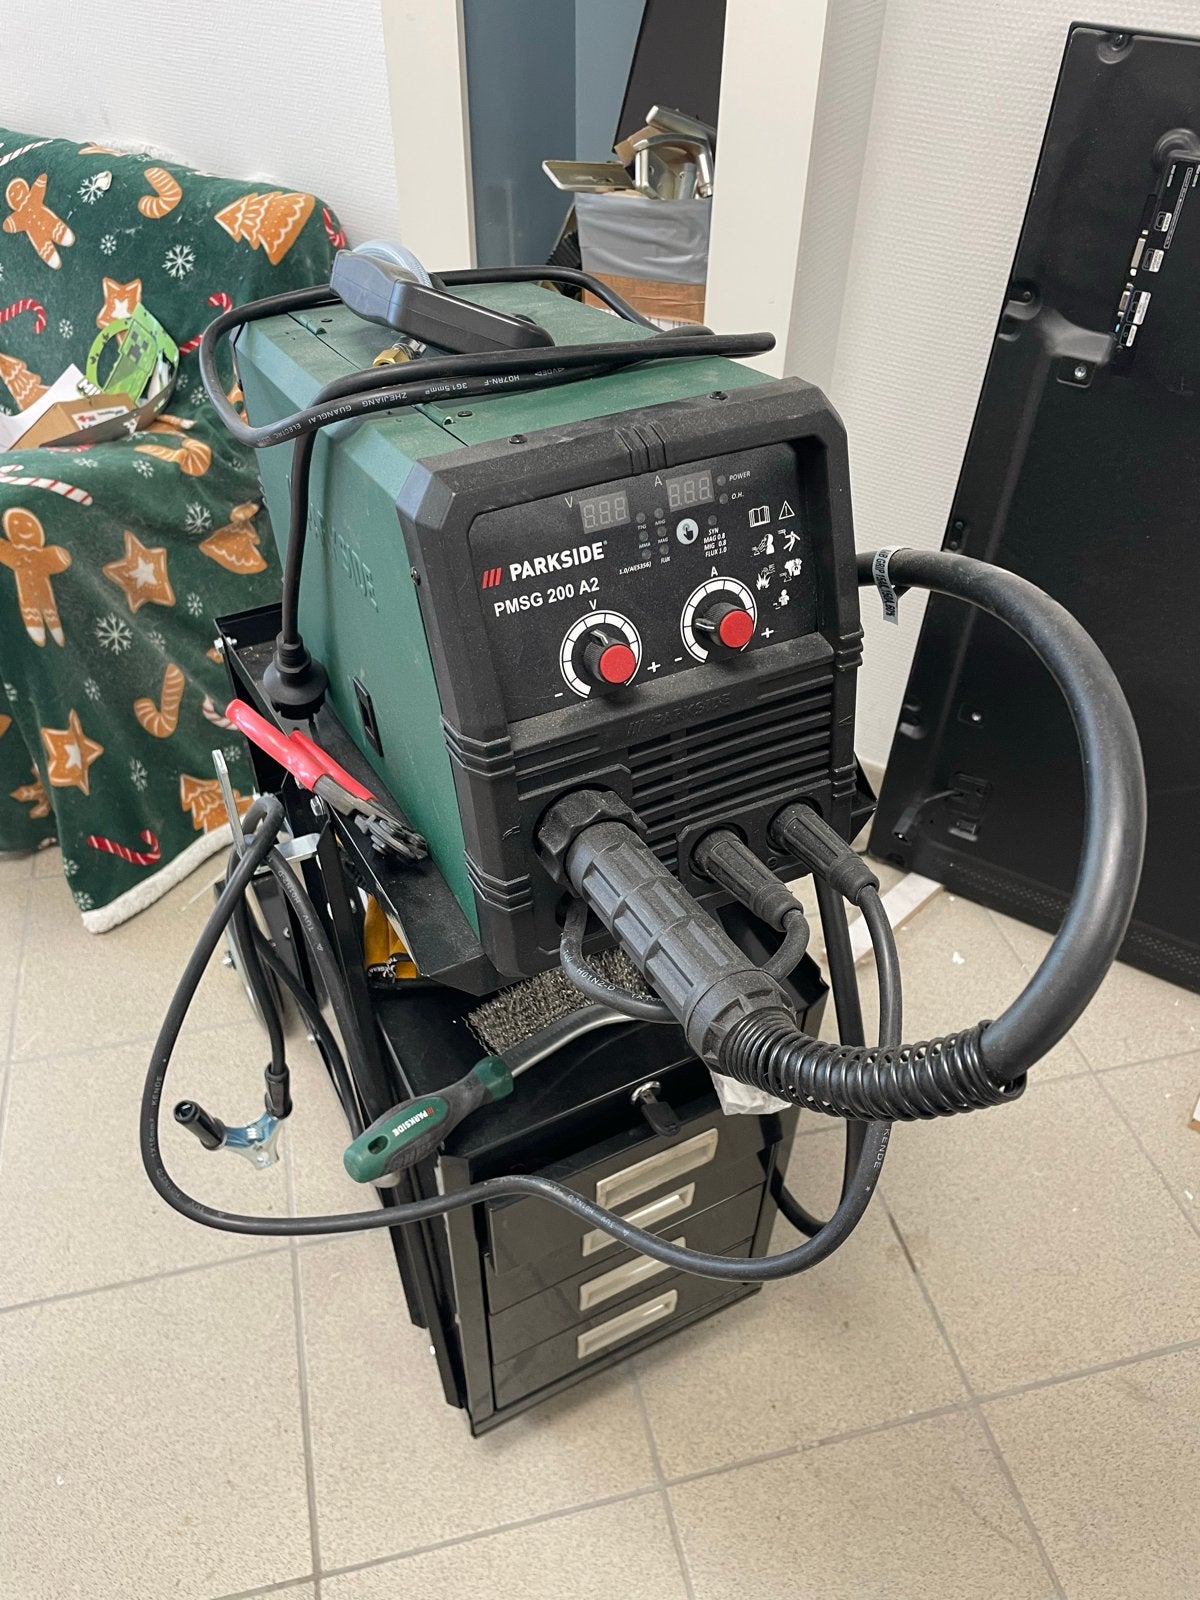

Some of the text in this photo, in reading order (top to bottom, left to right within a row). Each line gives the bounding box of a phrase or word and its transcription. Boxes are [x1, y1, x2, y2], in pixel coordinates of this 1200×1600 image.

[361, 391, 408, 408] ZHEJIANG
[307, 403, 353, 425] GUANGLAI
[728, 470, 751, 482] POWER
[564, 496, 574, 508] V
[508, 541, 605, 582] PARKSIDE
[710, 566, 718, 577] A
[493, 577, 600, 618] PMSG 200 A2
[588, 599, 597, 611] V
[391, 1108, 429, 1137] PARKSIDE
[873, 1128, 890, 1169] KENDE
